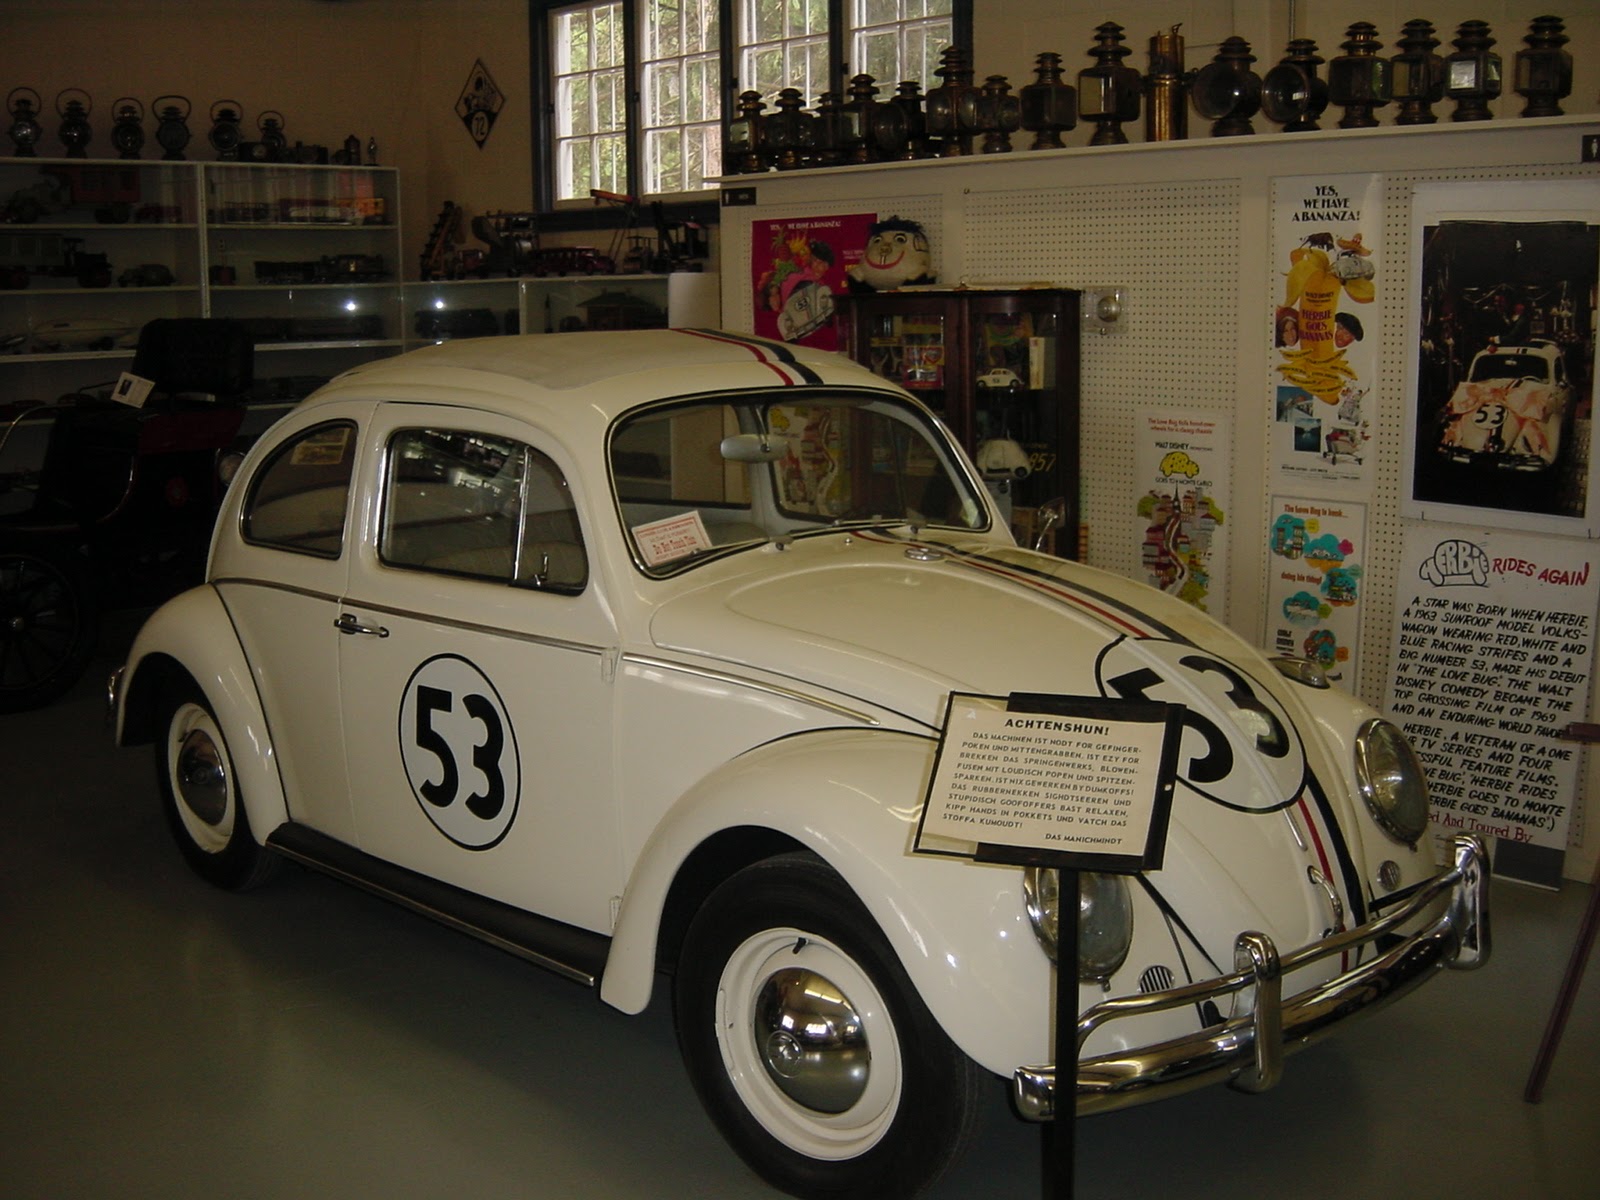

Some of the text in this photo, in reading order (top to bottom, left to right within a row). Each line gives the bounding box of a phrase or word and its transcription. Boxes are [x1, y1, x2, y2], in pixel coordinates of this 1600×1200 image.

[1304, 198, 1350, 209] WE HAVE
[1292, 211, 1360, 222] A BANANZA!
[1474, 404, 1506, 425] 53
[1493, 558, 1537, 578] RIDES
[1538, 562, 1590, 586] AGAIN
[1403, 607, 1411, 617] A
[1414, 609, 1437, 621] 1963
[1441, 612, 1493, 627] SUNROOF
[1496, 619, 1534, 633] MODEL
[1411, 596, 1421, 606] A
[1423, 598, 1449, 609] STAR
[1452, 601, 1473, 615] WAS
[1476, 603, 1507, 616] BORN
[1510, 608, 1545, 621] WHEN
[1401, 622, 1437, 635] WAGON
[1442, 627, 1493, 642] WEARING
[1560, 643, 1586, 655] AND
[1400, 634, 1427, 647] BLUE
[1430, 638, 1473, 654] RACING
[1532, 653, 1558, 665] AND
[1562, 657, 1572, 668] A
[1399, 648, 1586, 683] BIG NUMBER 53, MADE HIS DEBUT
[1396, 662, 1409, 672] IN
[1440, 669, 1469, 681] LOVE
[1507, 678, 1531, 690] THE
[1538, 683, 1573, 696] WALT
[1395, 675, 1573, 711] DISNEY COMEDY BECAME THE
[1394, 689, 1556, 722] TOP GROSSING FILM OF 1969
[1005, 719, 1109, 736] ACHTENSHUN!
[1392, 703, 1532, 734] AND AN ENDURING WORLD
[973, 732, 989, 740] DAS
[990, 734, 1033, 743] MACHINEN
[1034, 737, 1048, 745] IST
[1050, 739, 1073, 747] NODT
[1450, 731, 1572, 760] A VETERAN OF A ONE
[416, 685, 505, 820] 53
[960, 752, 999, 761] BREKKEN
[962, 741, 990, 750] POKEN
[1087, 753, 1100, 761] IST
[1102, 755, 1120, 763] EZY
[1421, 737, 1436, 749] TV
[1440, 742, 1482, 758] SERIES
[1488, 751, 1514, 764] AND
[1518, 755, 1552, 771] FOUR
[957, 763, 984, 771] FUSEN
[1002, 767, 1043, 777] LOUDISCH
[1045, 771, 1074, 780] POPEN
[1076, 774, 1094, 782] UND
[1460, 759, 1558, 786] FEATURE FILMS.
[951, 783, 1132, 807] DAS RUBBERNEKKEN SIGHDTSEEREN UND
[1009, 778, 1024, 786] NIX
[1025, 779, 1072, 790] GEWERKEN
[1072, 784, 1085, 792] BY
[1085, 785, 1134, 796] DUMKOFFS!
[1518, 784, 1557, 800] RIDES
[946, 803, 967, 812] KIPP
[969, 807, 997, 816] HANDS
[1013, 811, 1053, 821] POKKETS
[1056, 815, 1074, 823] UND
[1078, 817, 1108, 826] VATCH
[949, 793, 997, 804] STUPIDISCH
[1000, 799, 1056, 811] GOOFOFFERS
[1060, 805, 1082, 813] BAST
[1460, 802, 1488, 815] GOES
[1468, 789, 1499, 803] GOES
[1504, 795, 1519, 807] TO
[1522, 800, 1565, 817] MONTE
[943, 813, 1023, 828] STOFFA KUMOUDT!
[1443, 815, 1464, 830] And
[1469, 818, 1510, 839] Toured
[1515, 827, 1534, 843] By
[1045, 833, 1062, 841] DAS
